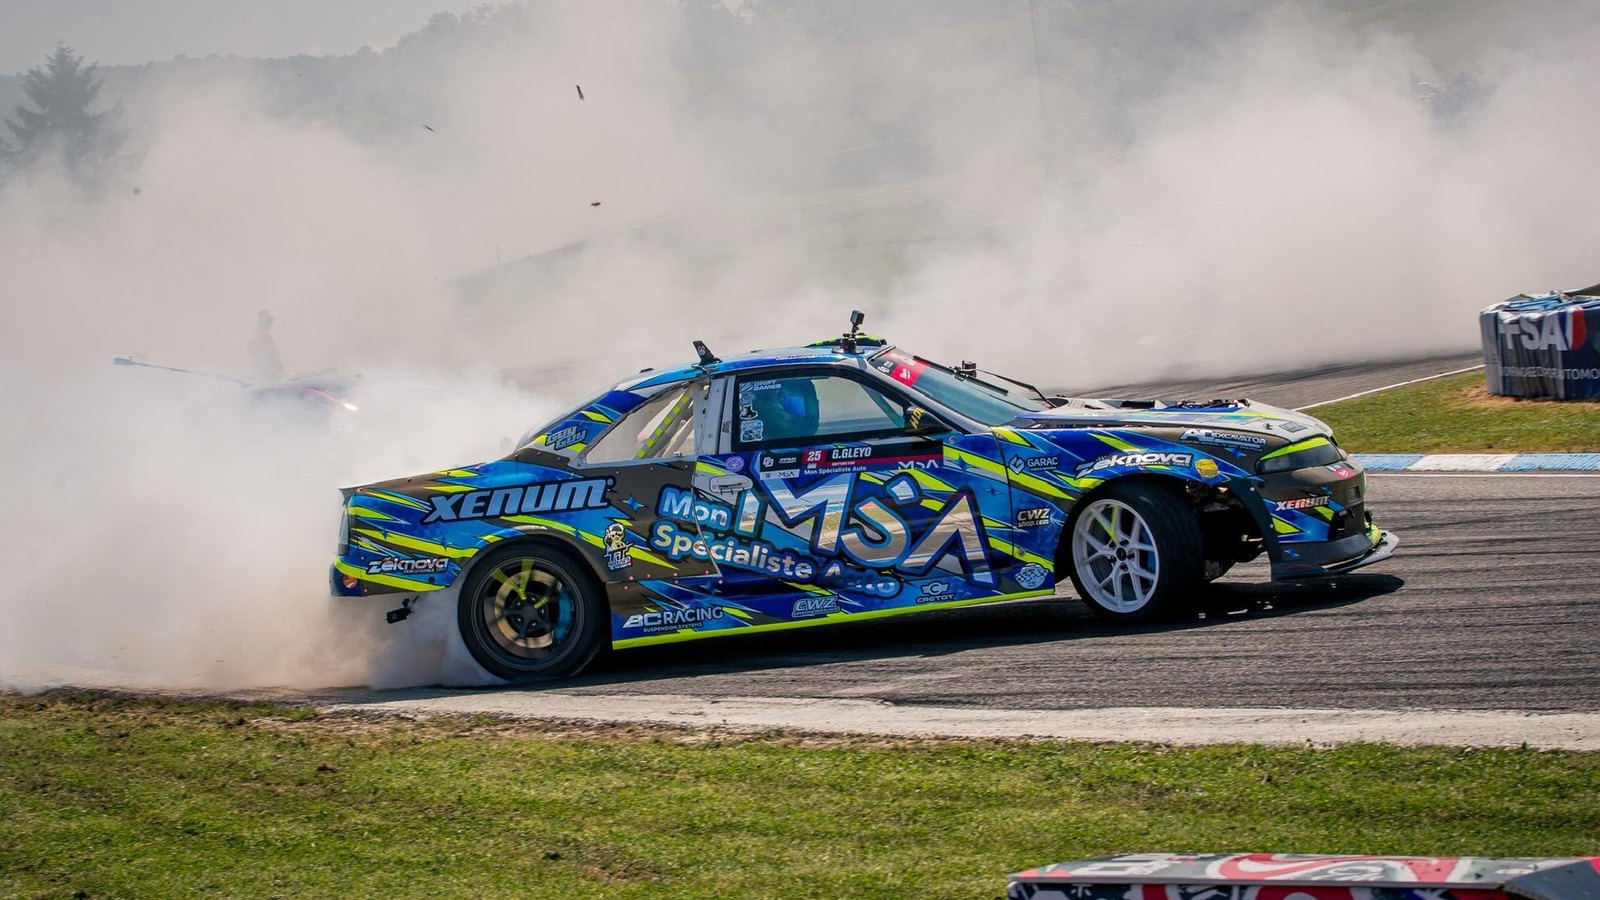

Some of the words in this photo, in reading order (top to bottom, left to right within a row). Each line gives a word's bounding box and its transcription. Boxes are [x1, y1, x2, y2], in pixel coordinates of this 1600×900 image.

[1213, 432, 1267, 445] EXCAVATOR
[807, 451, 821, 462] 25
[832, 447, 872, 459] G.GLEYO
[1027, 457, 1058, 467] GARAC
[423, 479, 608, 523] XENUM
[1275, 496, 1329, 511] XENUM
[663, 492, 728, 526] Mon
[1017, 508, 1050, 520] CWZ
[1018, 519, 1050, 528] shop.com
[622, 612, 662, 628] BC
[663, 606, 723, 624] RACING
[643, 625, 678, 633] SUSPENSION
